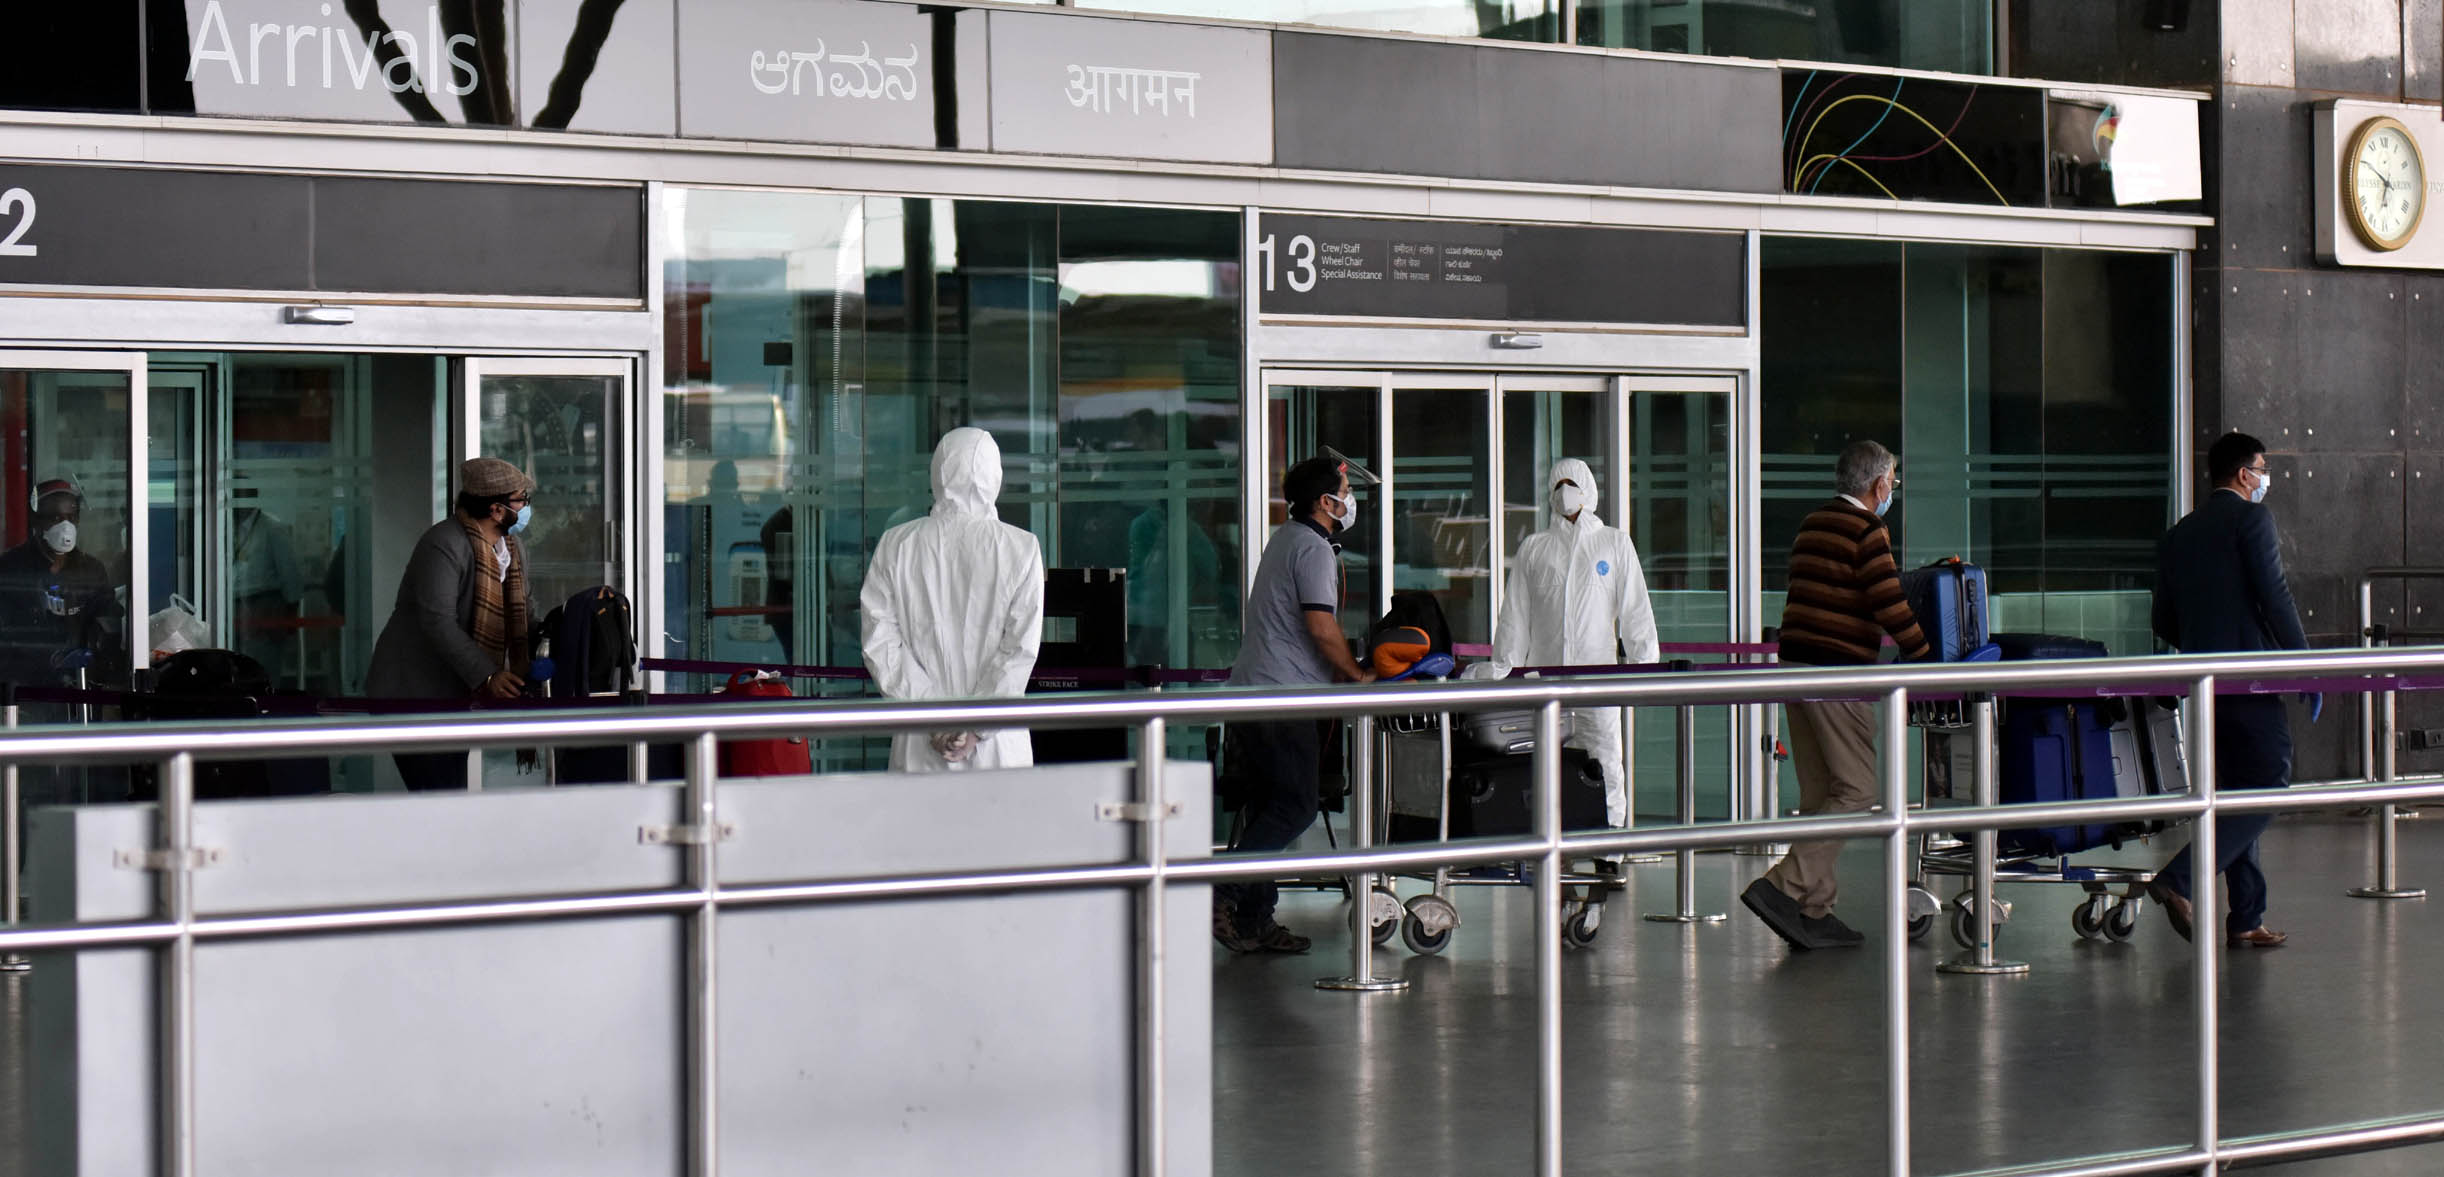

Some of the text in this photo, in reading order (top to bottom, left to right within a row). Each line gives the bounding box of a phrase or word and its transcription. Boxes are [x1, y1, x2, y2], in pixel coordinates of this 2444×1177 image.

[185, 0, 478, 96] Arrivals
[750, 37, 918, 101] ಆಗಮನ
[1065, 64, 1201, 118] आगमन
[0, 187, 37, 257] 2
[1258, 233, 1317, 293] 13
[1321, 255, 1363, 266] Wheel Chair
[1321, 268, 1346, 281] Special
[1346, 269, 1383, 280] Assistance
